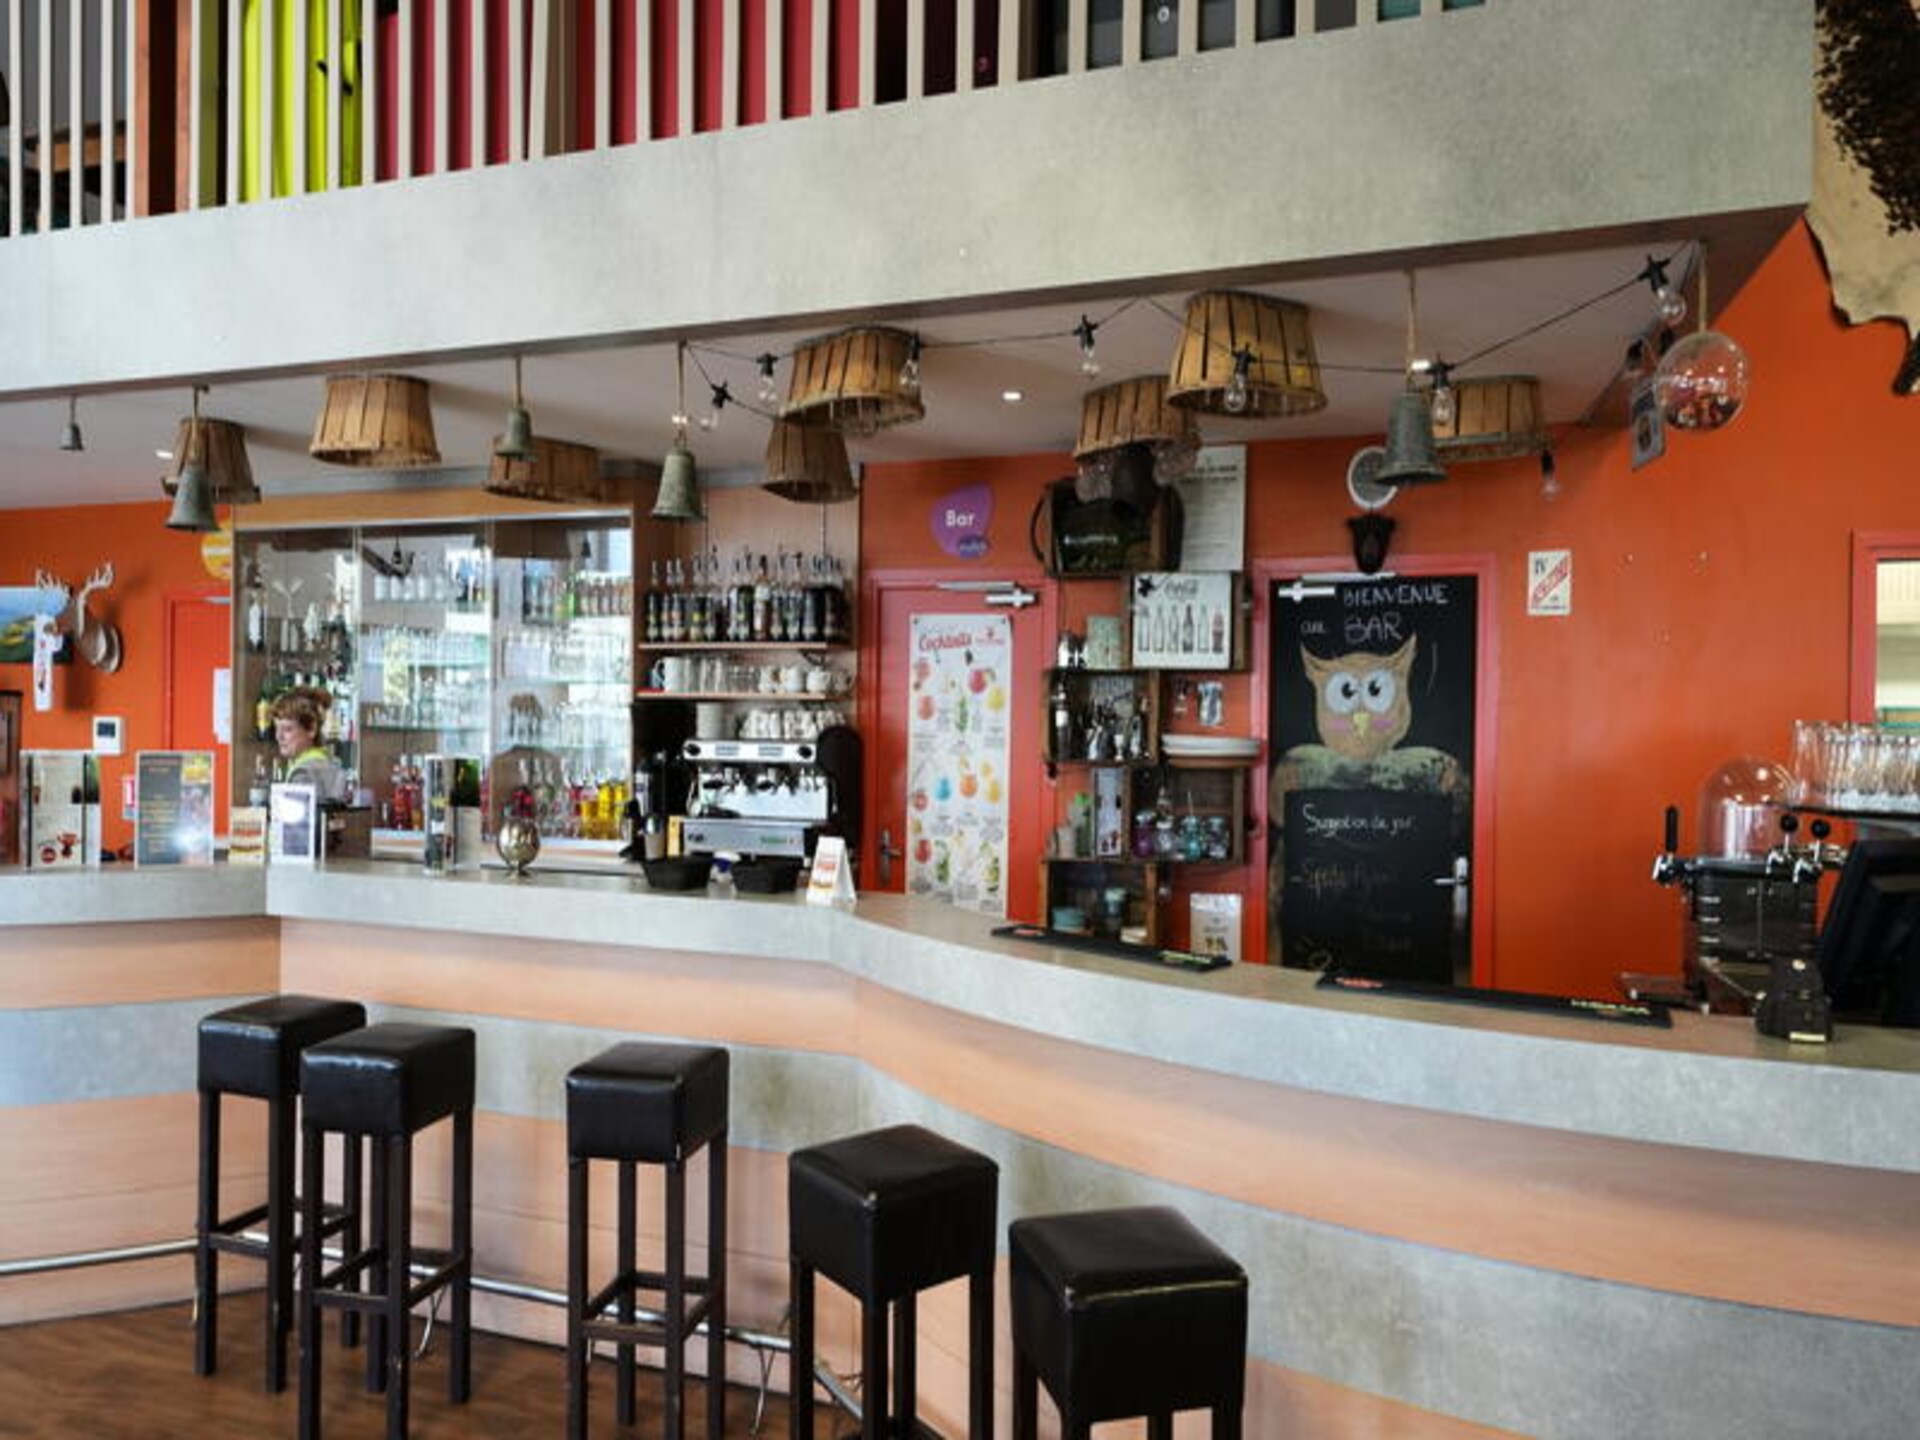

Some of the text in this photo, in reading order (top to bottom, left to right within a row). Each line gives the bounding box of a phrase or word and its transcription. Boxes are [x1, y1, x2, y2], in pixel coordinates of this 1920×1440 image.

[945, 509, 976, 527] Bar
[1342, 583, 1450, 608] BIENVENUE
[1344, 610, 1403, 645] BAR
